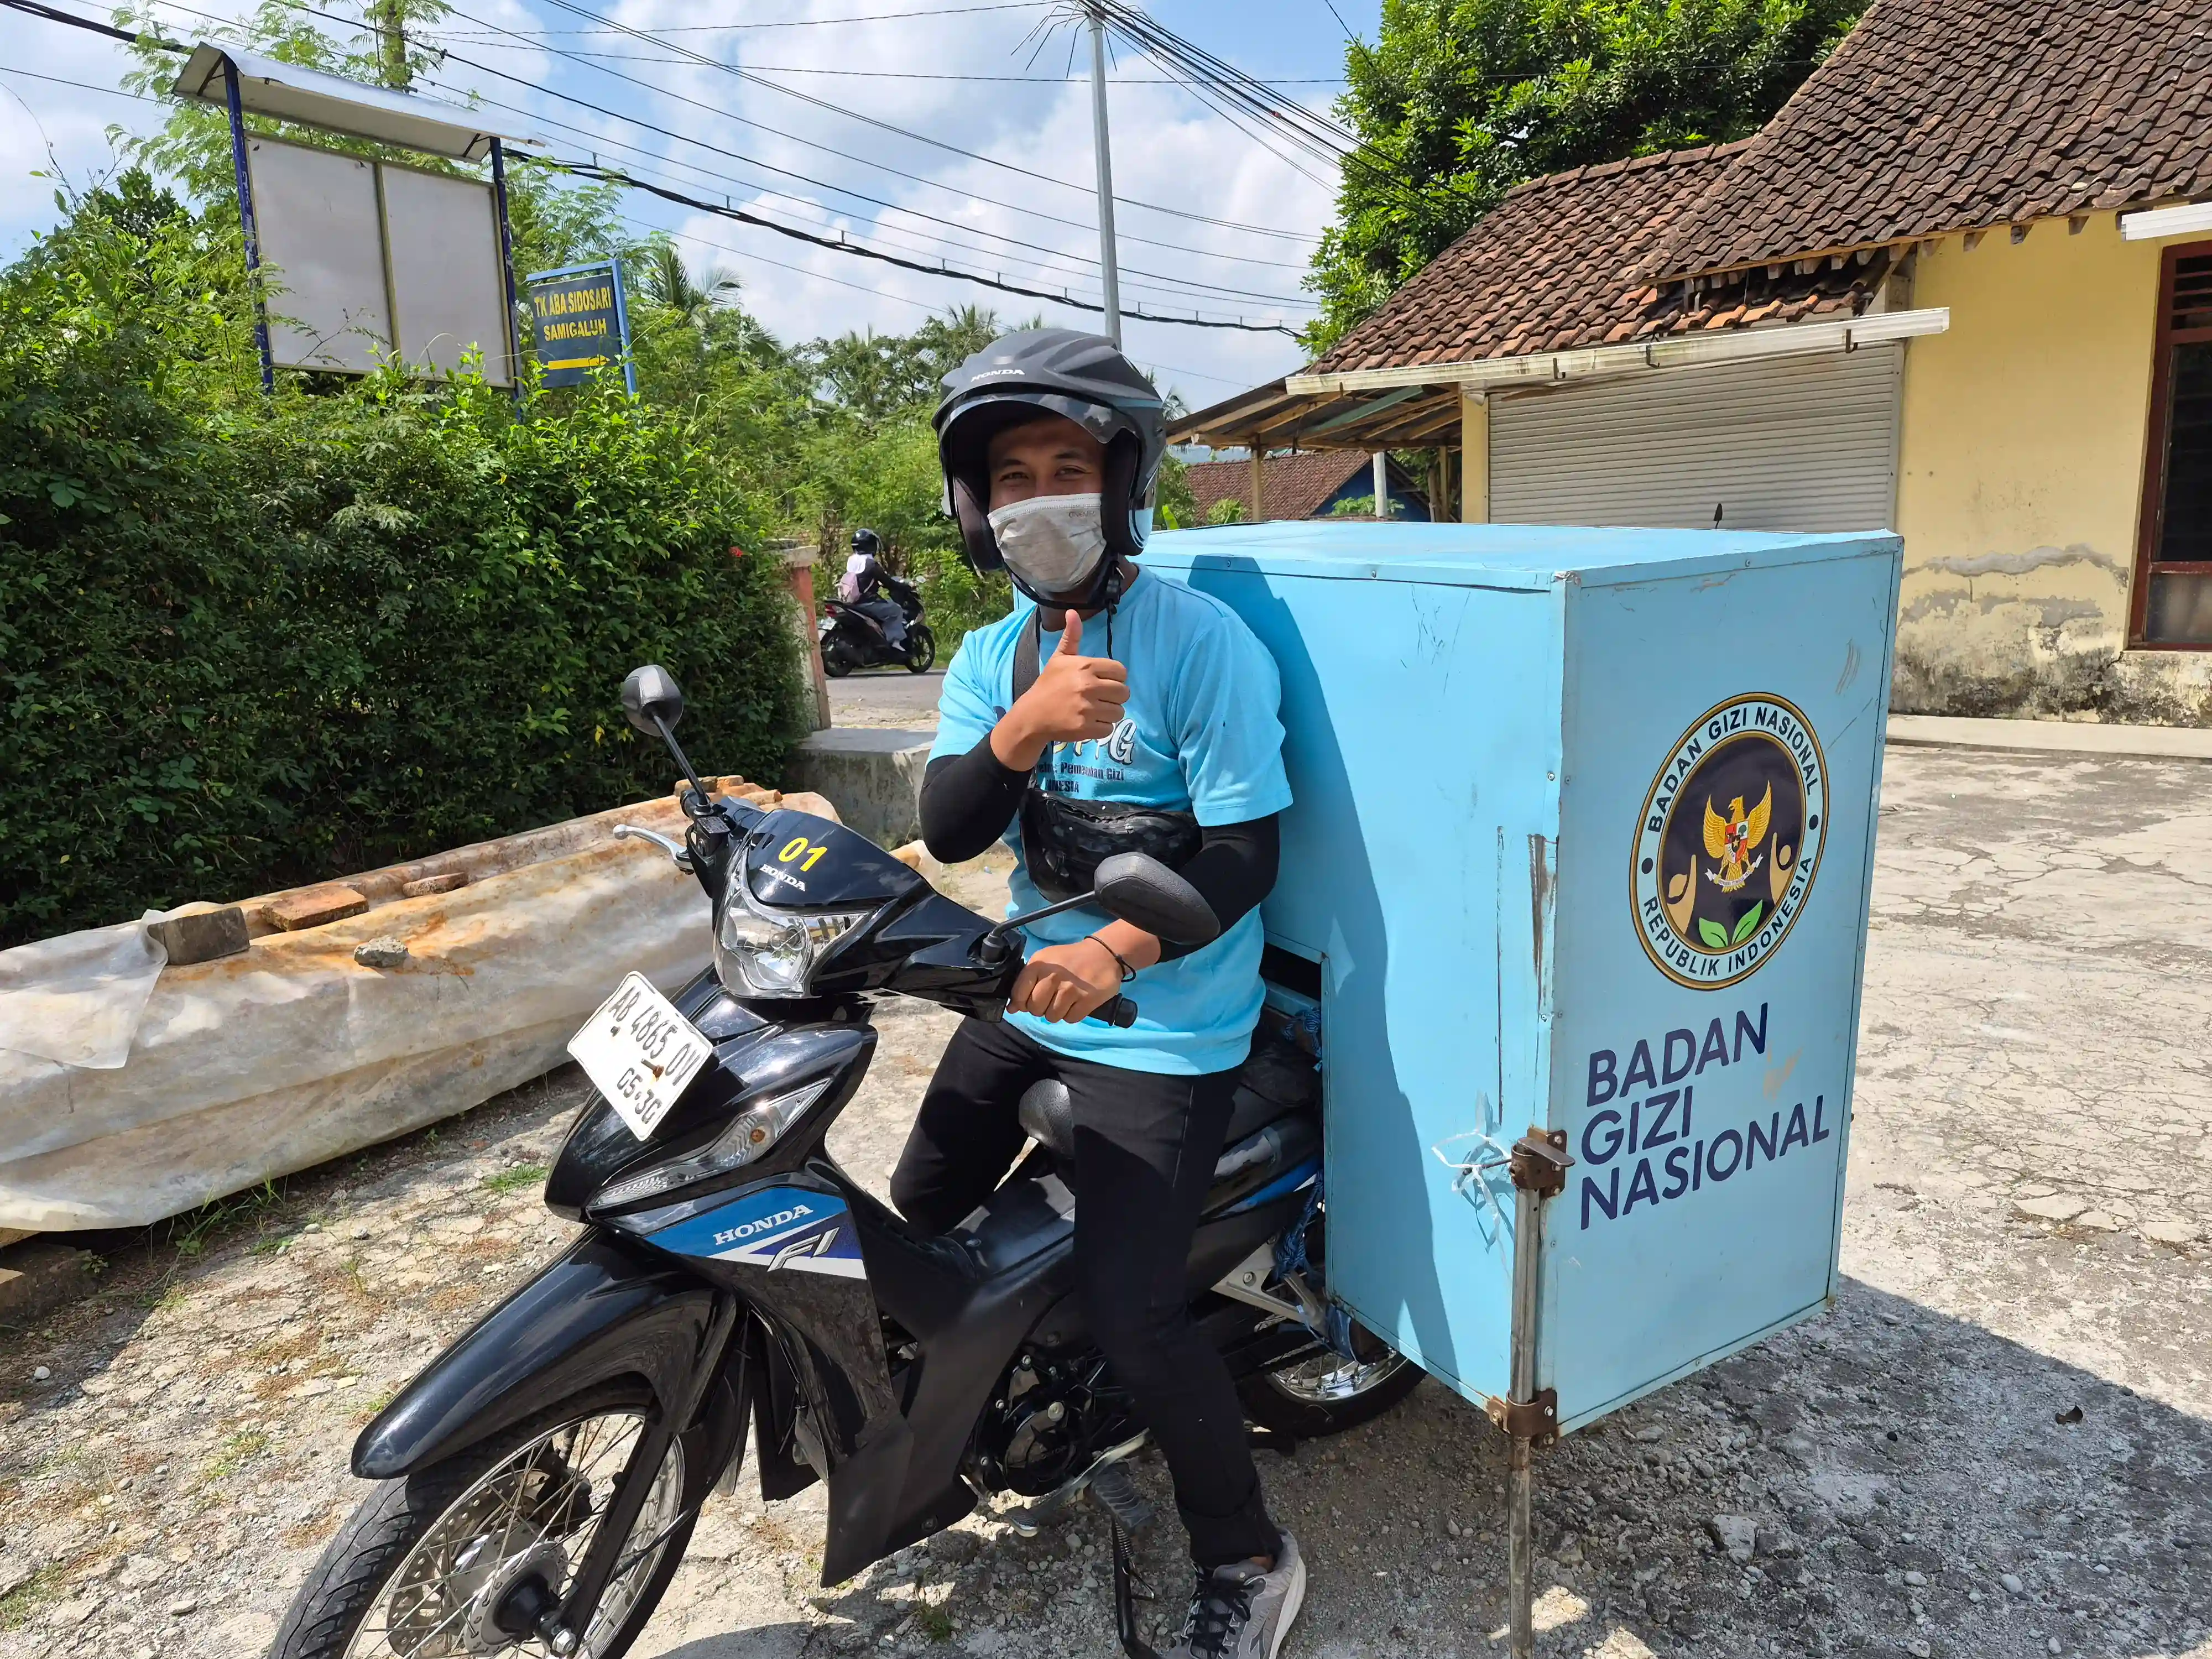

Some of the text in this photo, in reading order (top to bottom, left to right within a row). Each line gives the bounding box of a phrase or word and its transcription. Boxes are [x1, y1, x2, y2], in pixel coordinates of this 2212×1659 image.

[534, 286, 612, 317] TK ABA SIDOSARI
[544, 319, 607, 341] SAMIGALUH
[971, 369, 1025, 382] HONDA
[1107, 768, 1124, 780] Gizi
[1648, 706, 1819, 833] BADAN GIZI NASIONAL
[779, 837, 828, 872] 01
[759, 864, 806, 891] HONDA
[1644, 857, 1812, 977] REPUBLIK INDONESIA
[608, 985, 641, 1022] AB
[631, 1005, 678, 1059] 4865
[1587, 1002, 1768, 1107] BADAN
[1581, 1086, 1693, 1165] GIZI
[1580, 1094, 1829, 1230] NASIONAL
[713, 1204, 813, 1245] HONDA
